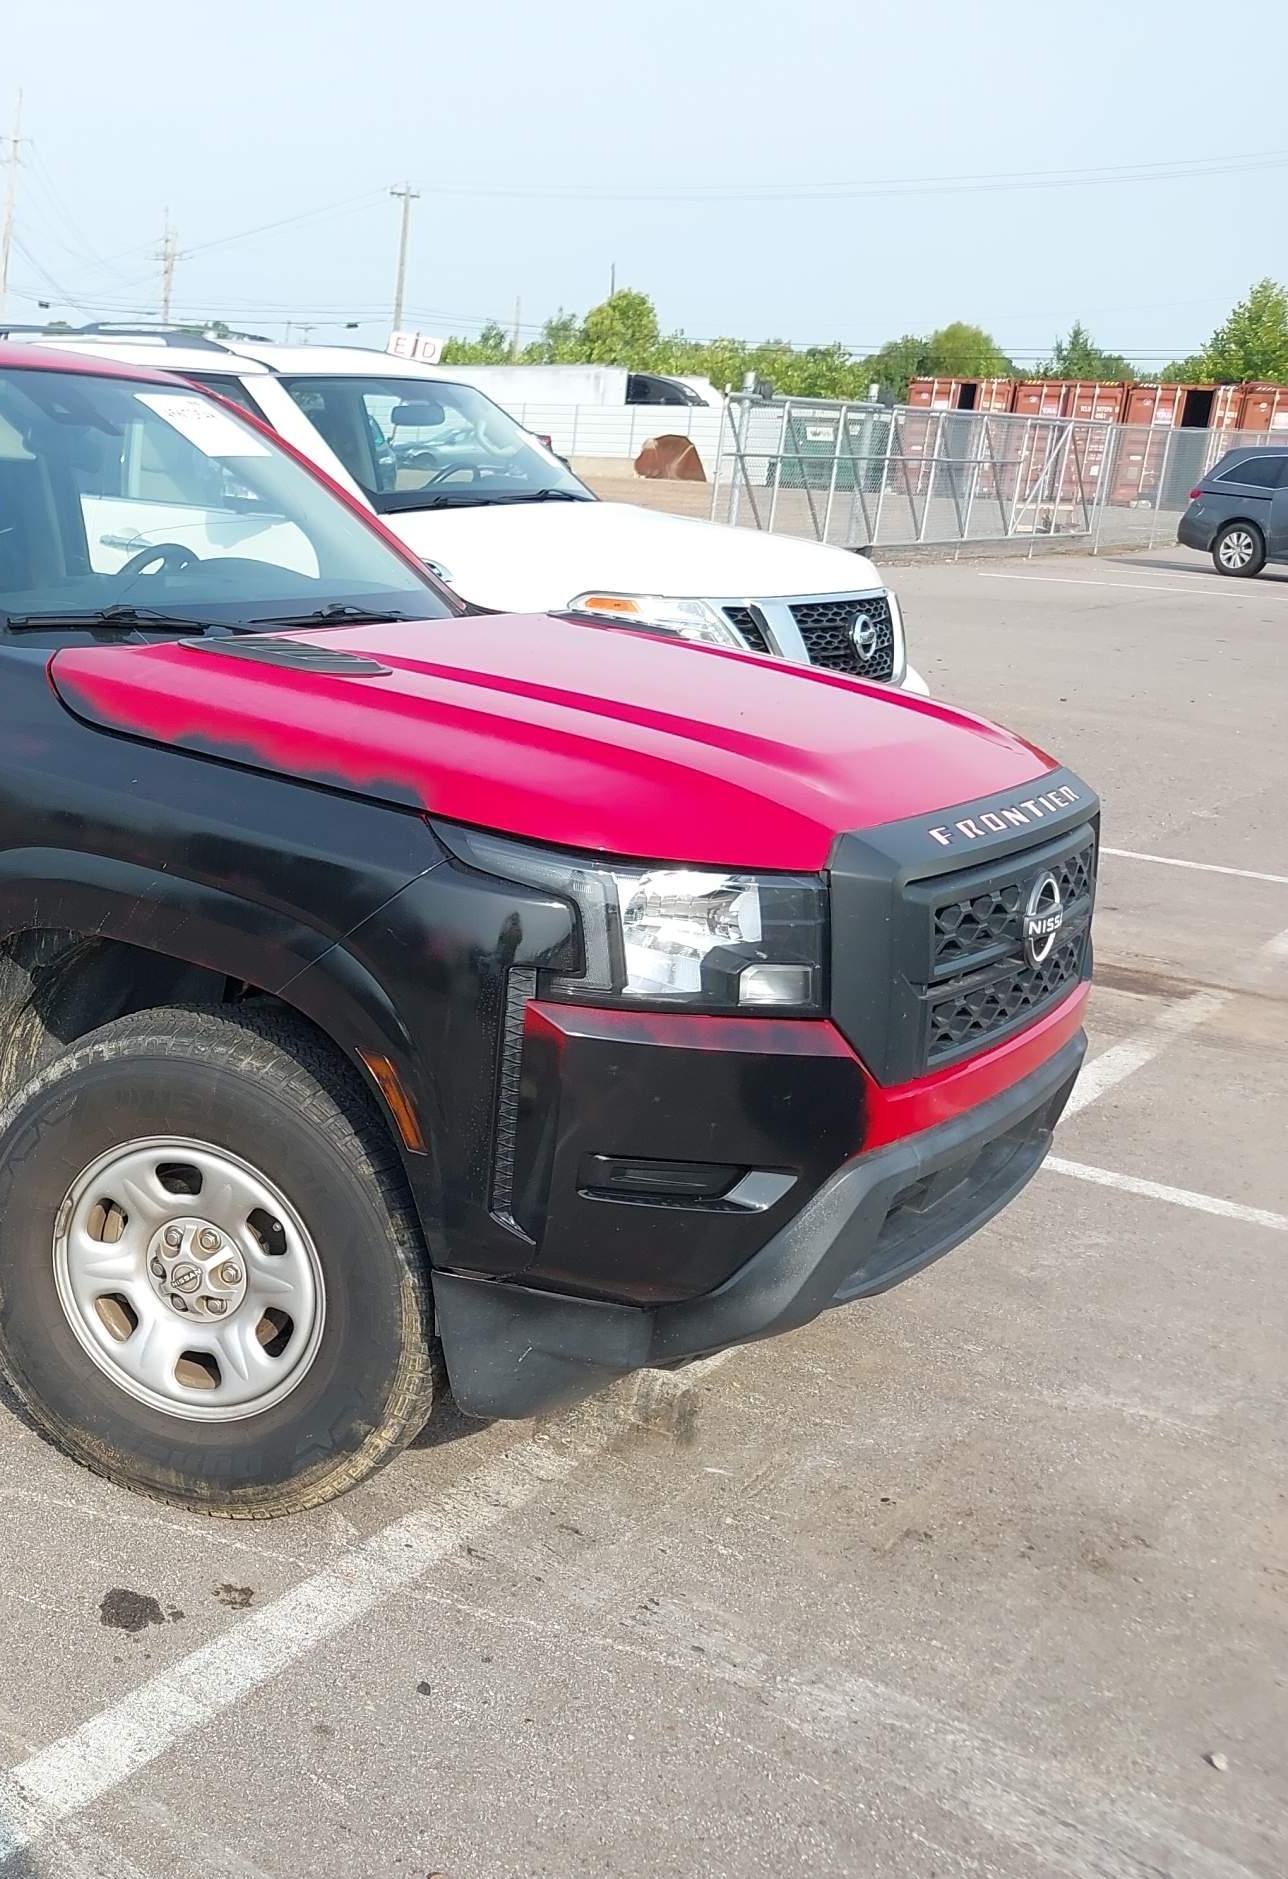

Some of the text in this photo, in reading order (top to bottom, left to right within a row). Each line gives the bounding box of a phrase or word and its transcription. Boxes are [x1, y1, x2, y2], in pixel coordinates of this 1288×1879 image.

[928, 785, 1080, 846] FRONTIER
[1028, 914, 1062, 935] NISS
[171, 1267, 202, 1288] NISSAN
